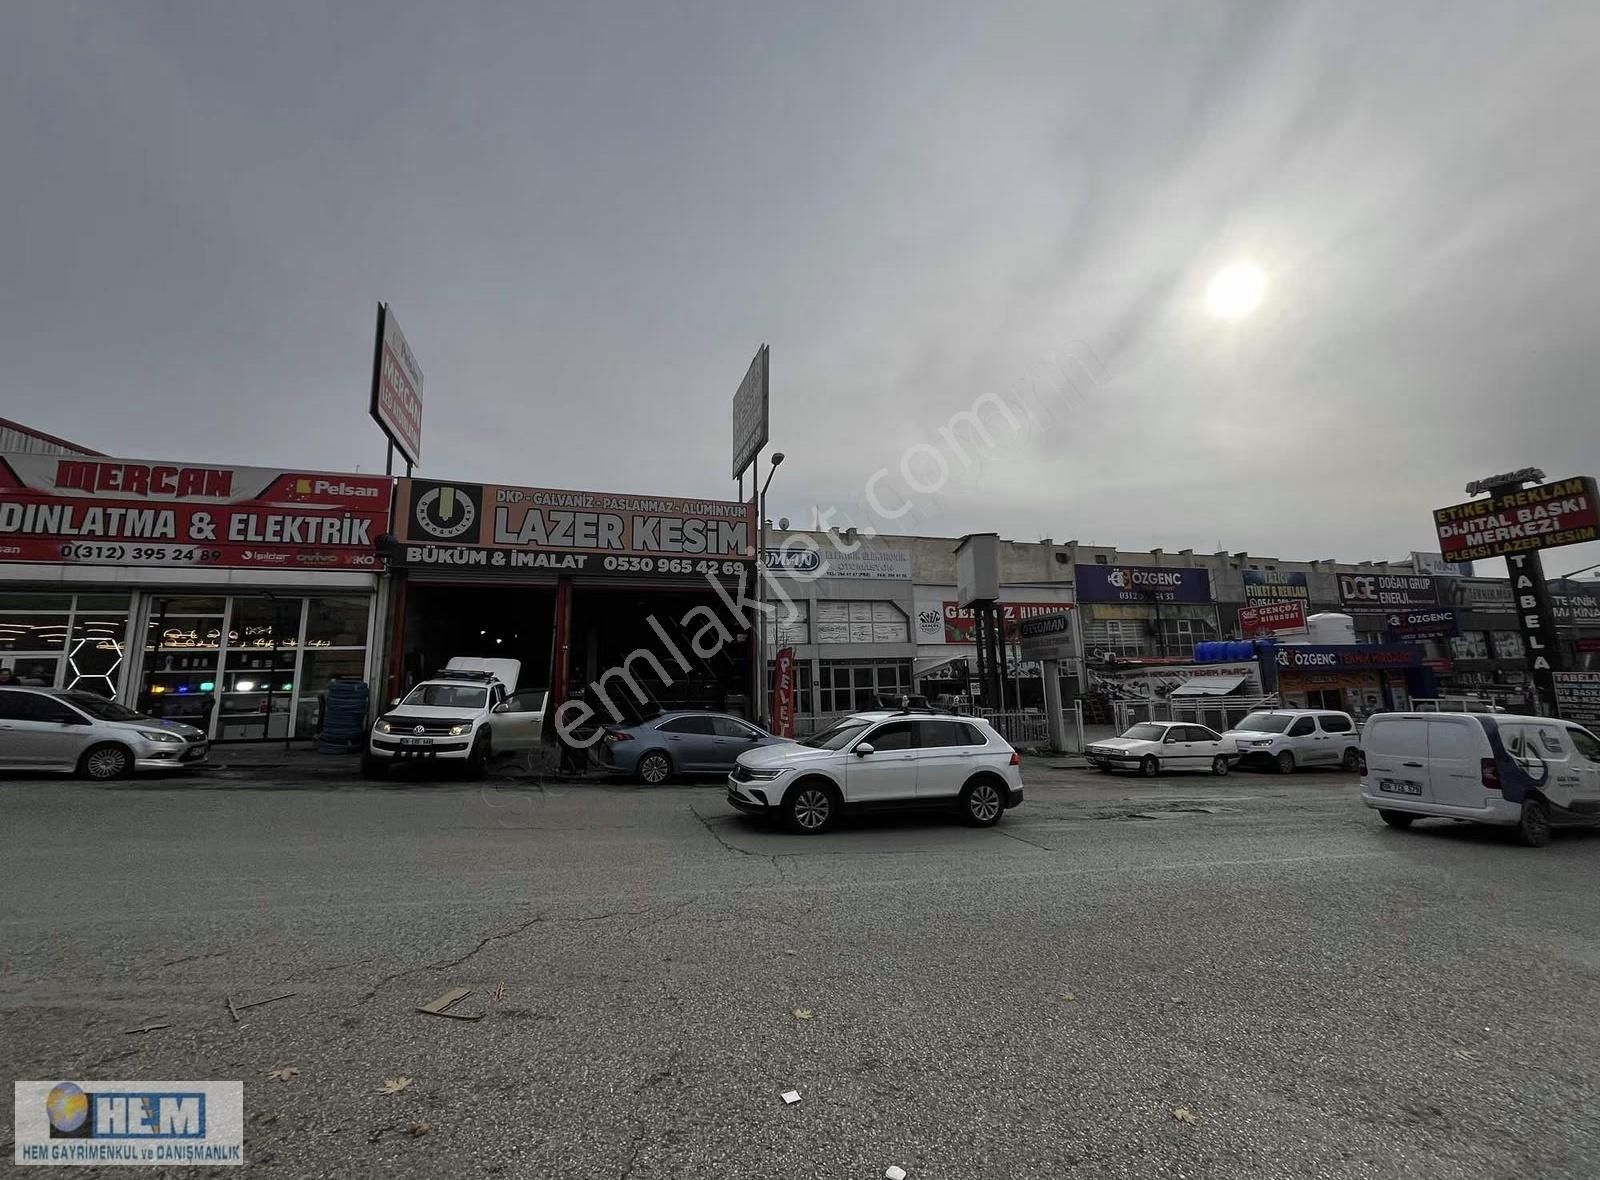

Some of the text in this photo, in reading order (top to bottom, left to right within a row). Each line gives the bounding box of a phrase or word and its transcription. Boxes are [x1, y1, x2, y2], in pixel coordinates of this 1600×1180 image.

[384, 356, 419, 424] MERCAN
[56, 460, 233, 497] MERCAN
[314, 480, 378, 497] Pelsan
[496, 489, 523, 502] DKP
[534, 492, 593, 508] GALVANİZ
[604, 499, 673, 513] PASLANMAZ
[682, 502, 746, 518] ALÜMİNYUM
[1440, 497, 1587, 538] DİJİTAL BASKI
[190, 512, 216, 541] &
[228, 512, 372, 545] ELEKTRİK
[496, 507, 748, 555] LAZER KESİM
[1445, 527, 1595, 561] PLEKSİ LAZER KESİM
[1466, 517, 1560, 546] MERKEZİ
[61, 545, 221, 561] 0(312) 395 24 89
[406, 545, 744, 576] BÜKÜM & İMALAT 0530 965 42 69
[1246, 584, 1271, 597] ETİKET
[1379, 576, 1408, 589] DOĞAN
[1409, 578, 1430, 589] GRUP
[1510, 554, 1551, 669] TABELA
